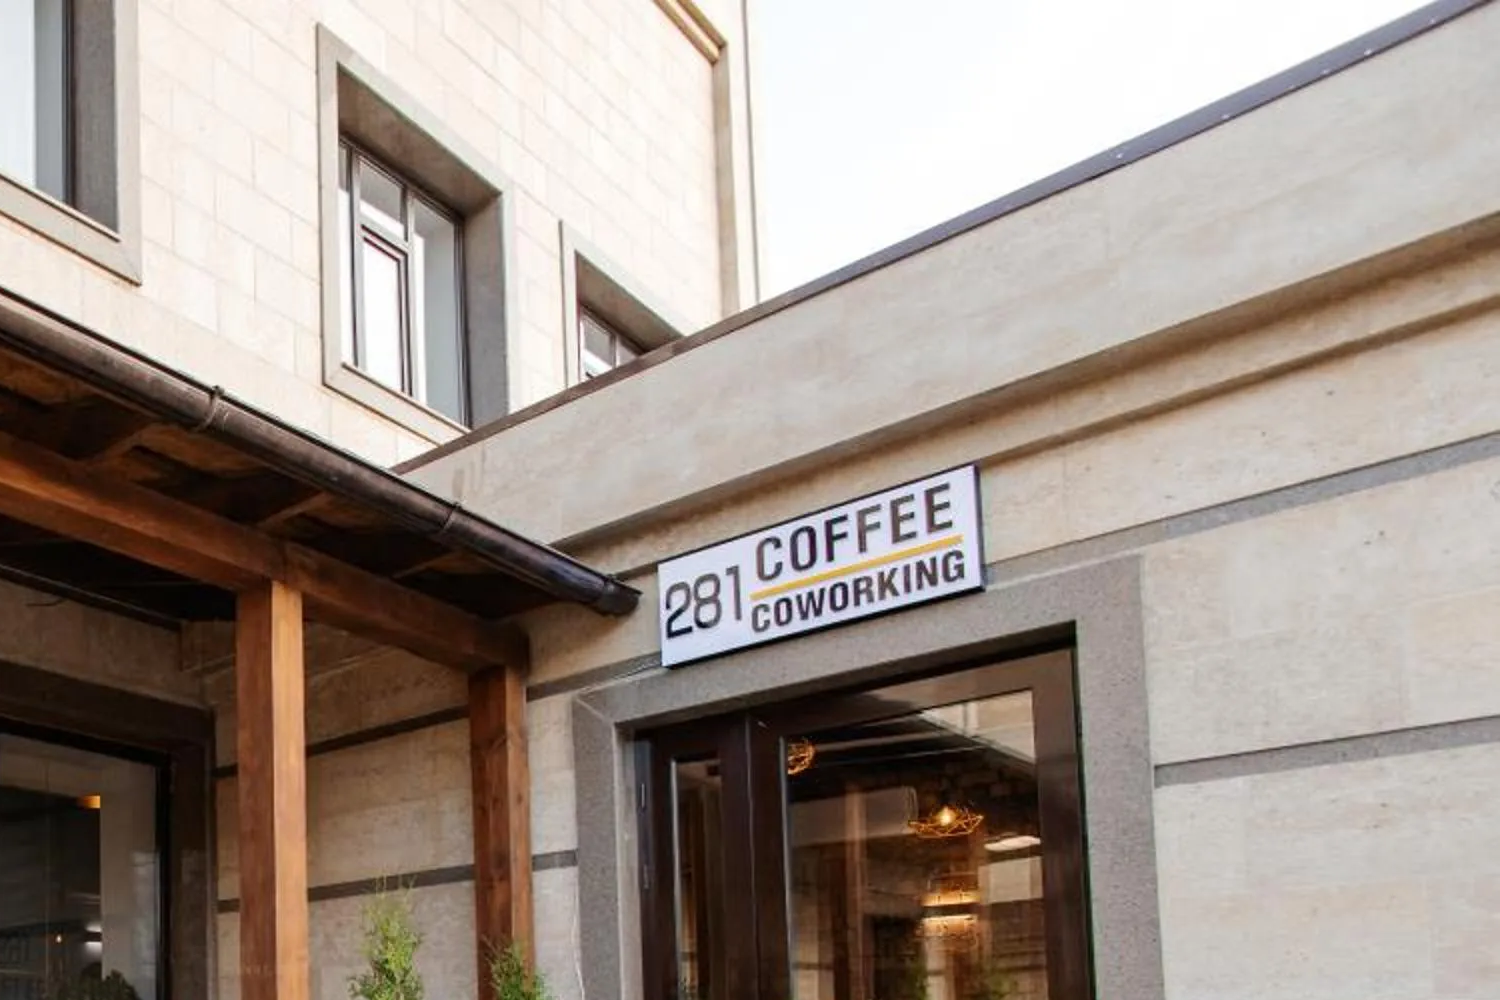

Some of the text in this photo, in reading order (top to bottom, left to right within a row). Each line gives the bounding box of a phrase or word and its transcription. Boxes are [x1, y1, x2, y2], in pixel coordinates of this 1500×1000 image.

[756, 483, 953, 581] COFFEE
[665, 565, 743, 638] 281
[751, 550, 965, 633] COWORKING
